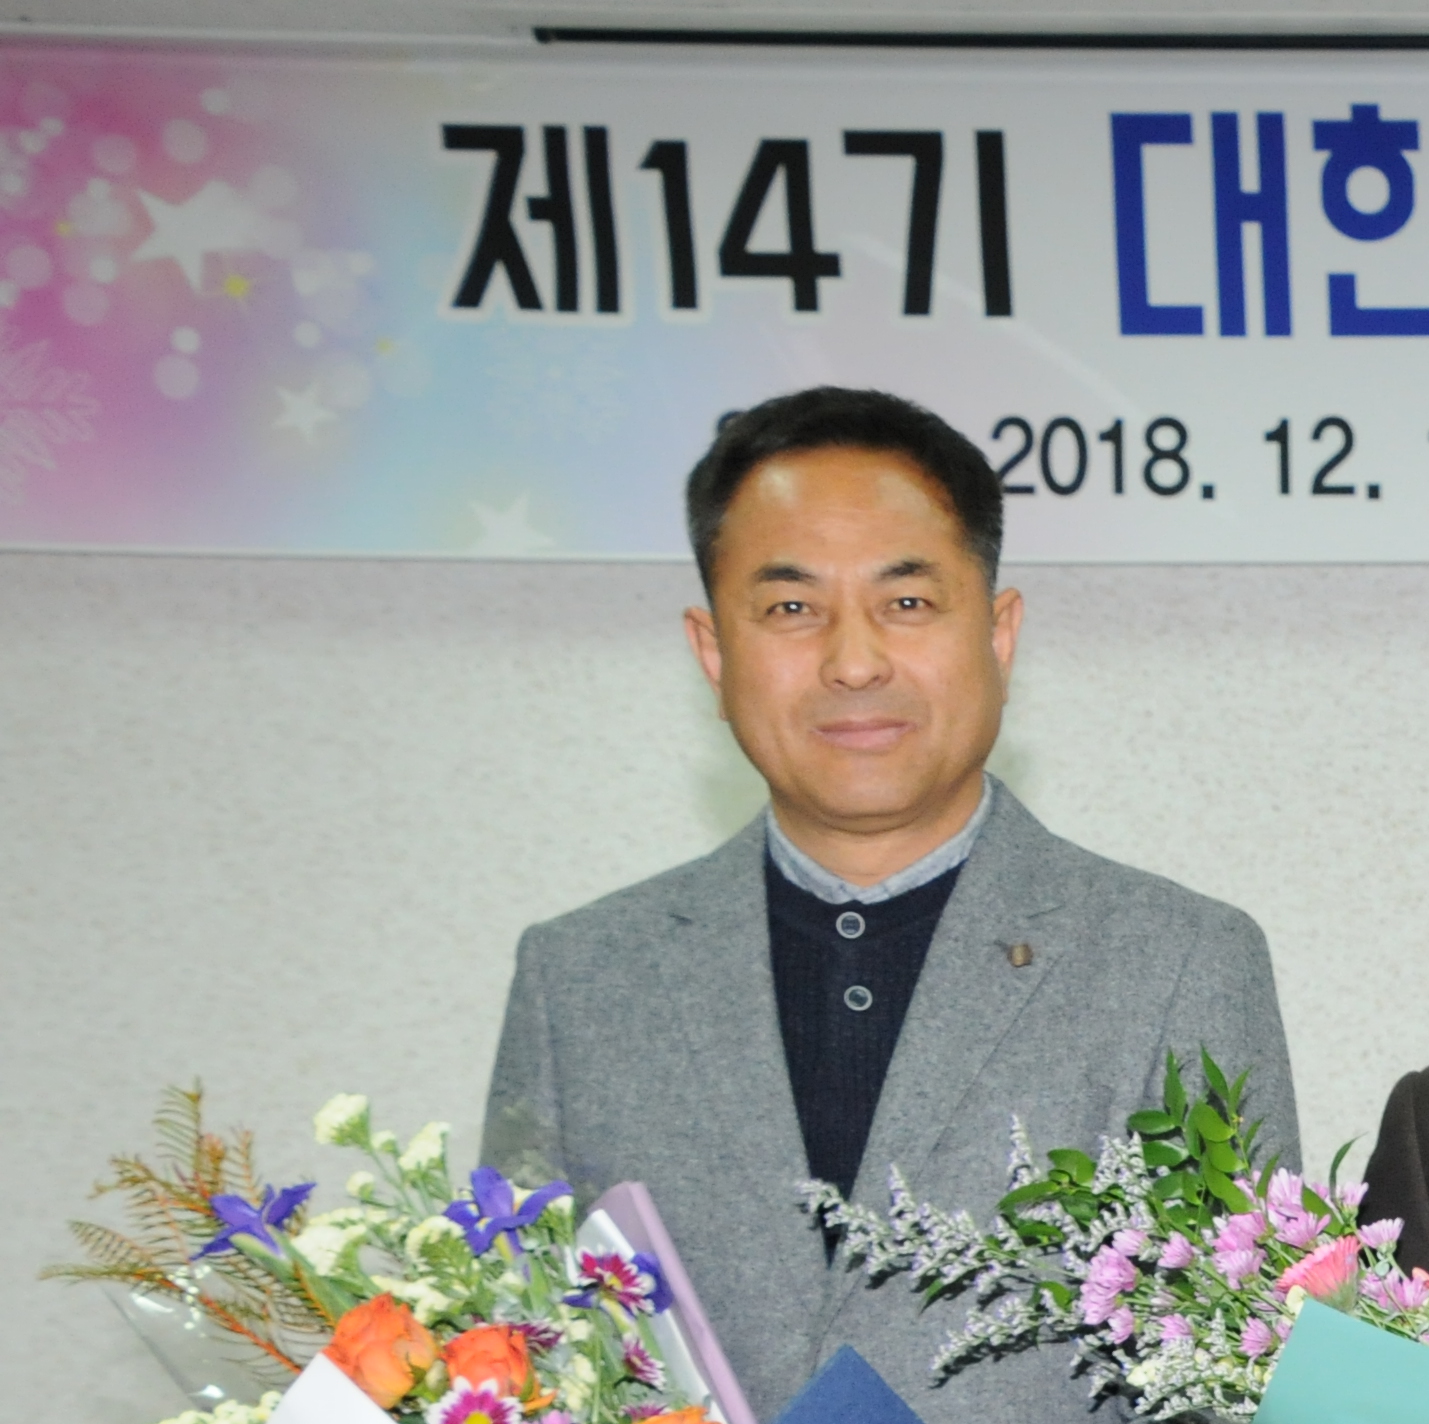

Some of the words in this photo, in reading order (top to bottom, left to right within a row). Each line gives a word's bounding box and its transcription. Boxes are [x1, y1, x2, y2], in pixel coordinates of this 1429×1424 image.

[439, 121, 1015, 319] 제14기
[991, 415, 1215, 500] 2018.
[1263, 415, 1381, 500] 12.
